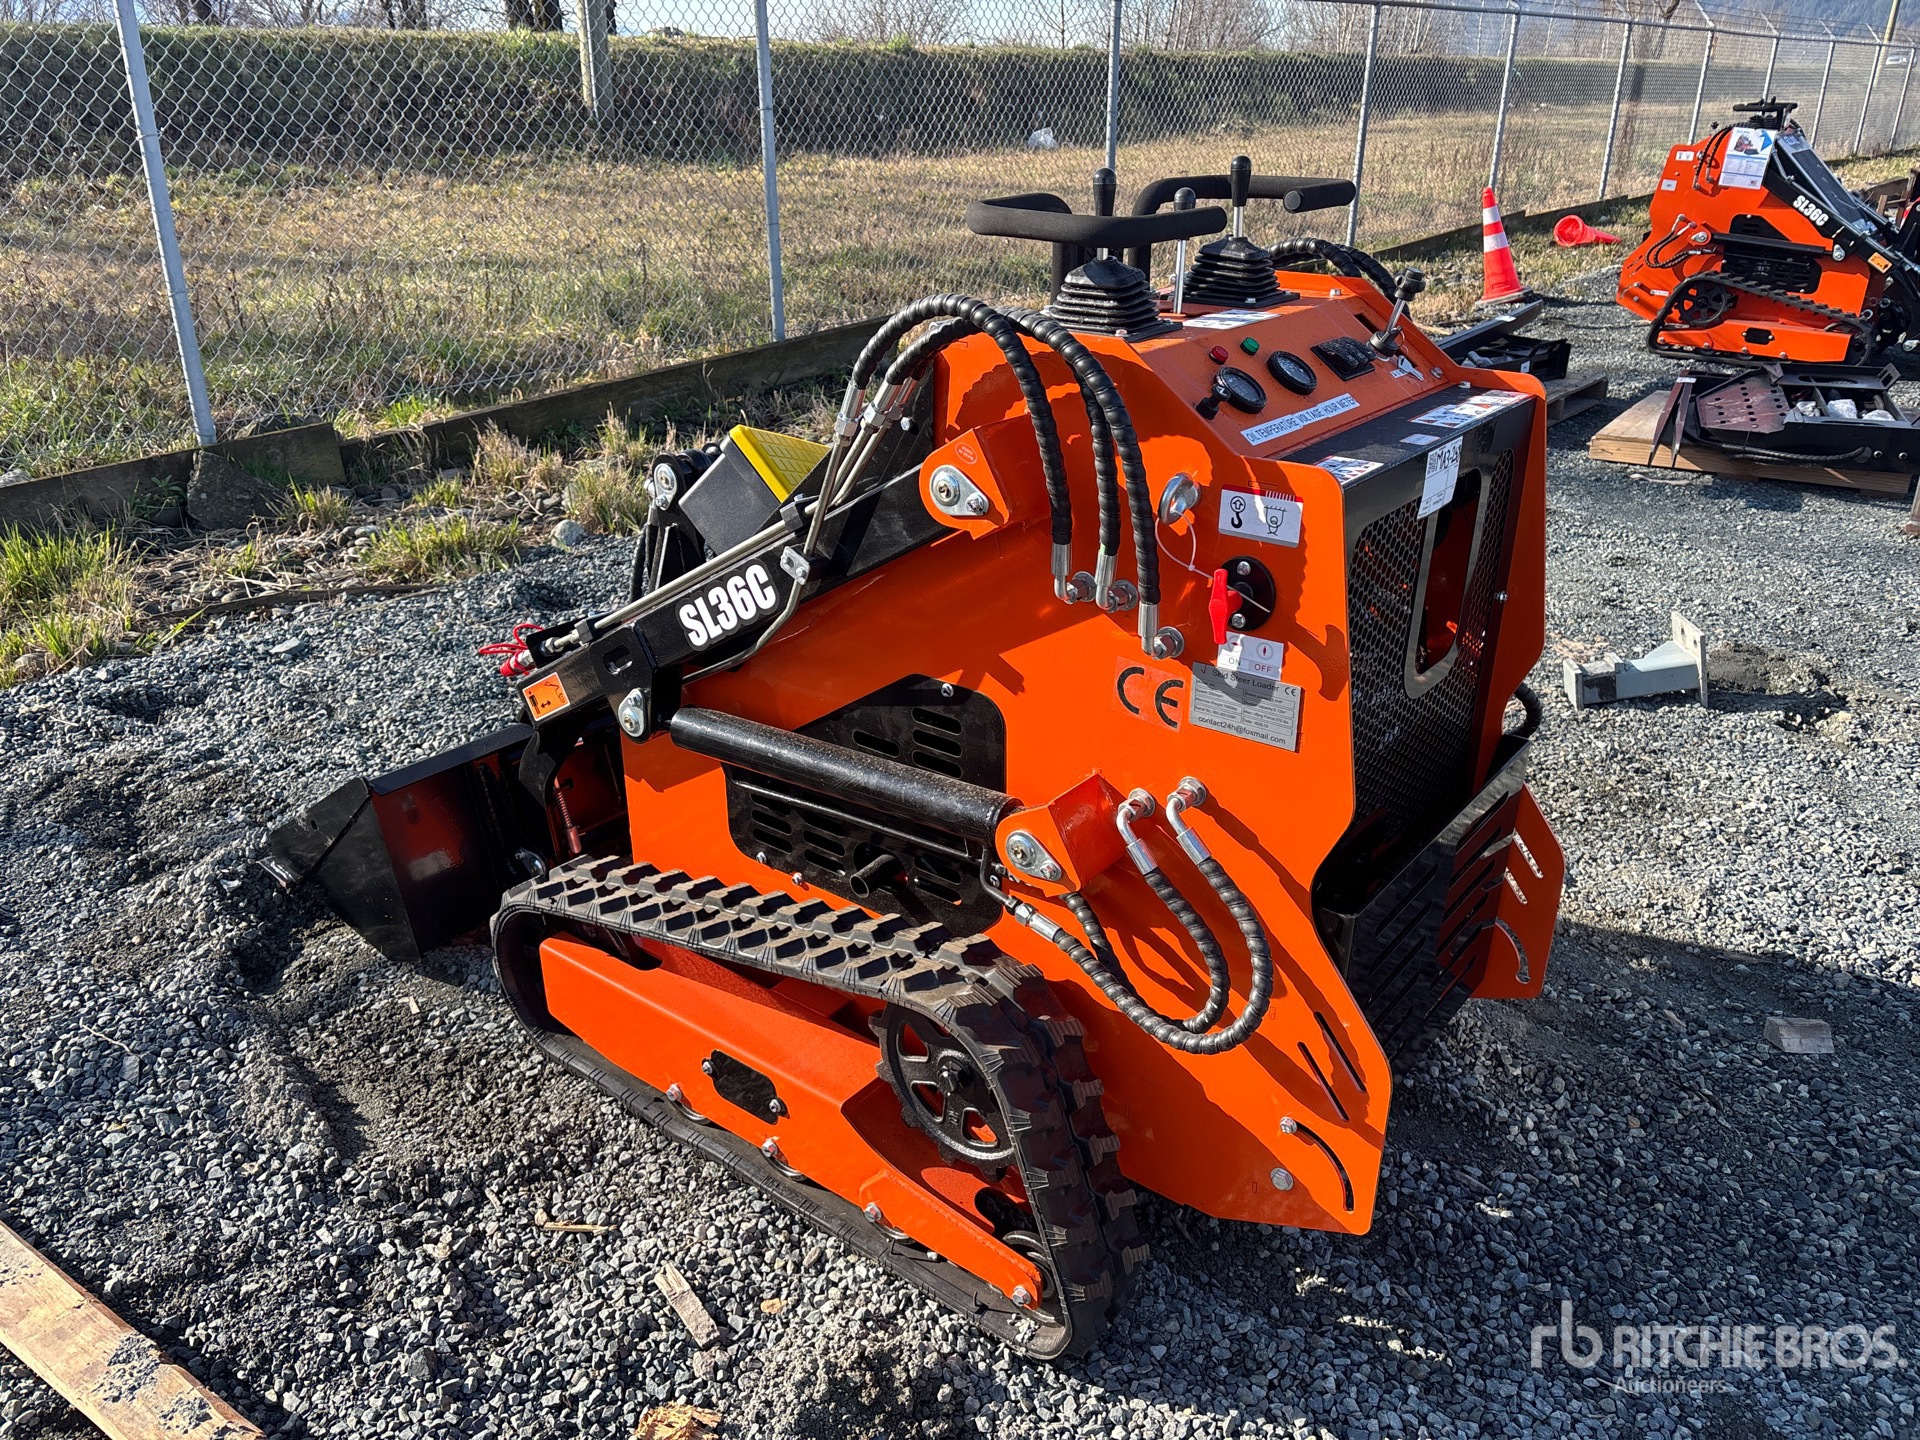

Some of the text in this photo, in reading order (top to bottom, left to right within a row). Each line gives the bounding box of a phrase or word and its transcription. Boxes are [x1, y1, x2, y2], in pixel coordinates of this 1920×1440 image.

[1793, 195, 1829, 226] SL36C
[1246, 430, 1261, 442] OIL
[1254, 417, 1299, 439] TEMPERATURE
[1295, 408, 1324, 424] VOLTAGE
[1321, 402, 1341, 415] HOUR
[679, 564, 776, 647] SL36C
[1212, 669, 1229, 680] Skid
[1230, 673, 1251, 685] Steer
[1252, 679, 1280, 692] Loader
[1254, 663, 1273, 673] OFF
[1116, 666, 1184, 729] CE
[1284, 686, 1297, 697] CE
[1198, 715, 1286, 745] contact24h@foxmail.com
